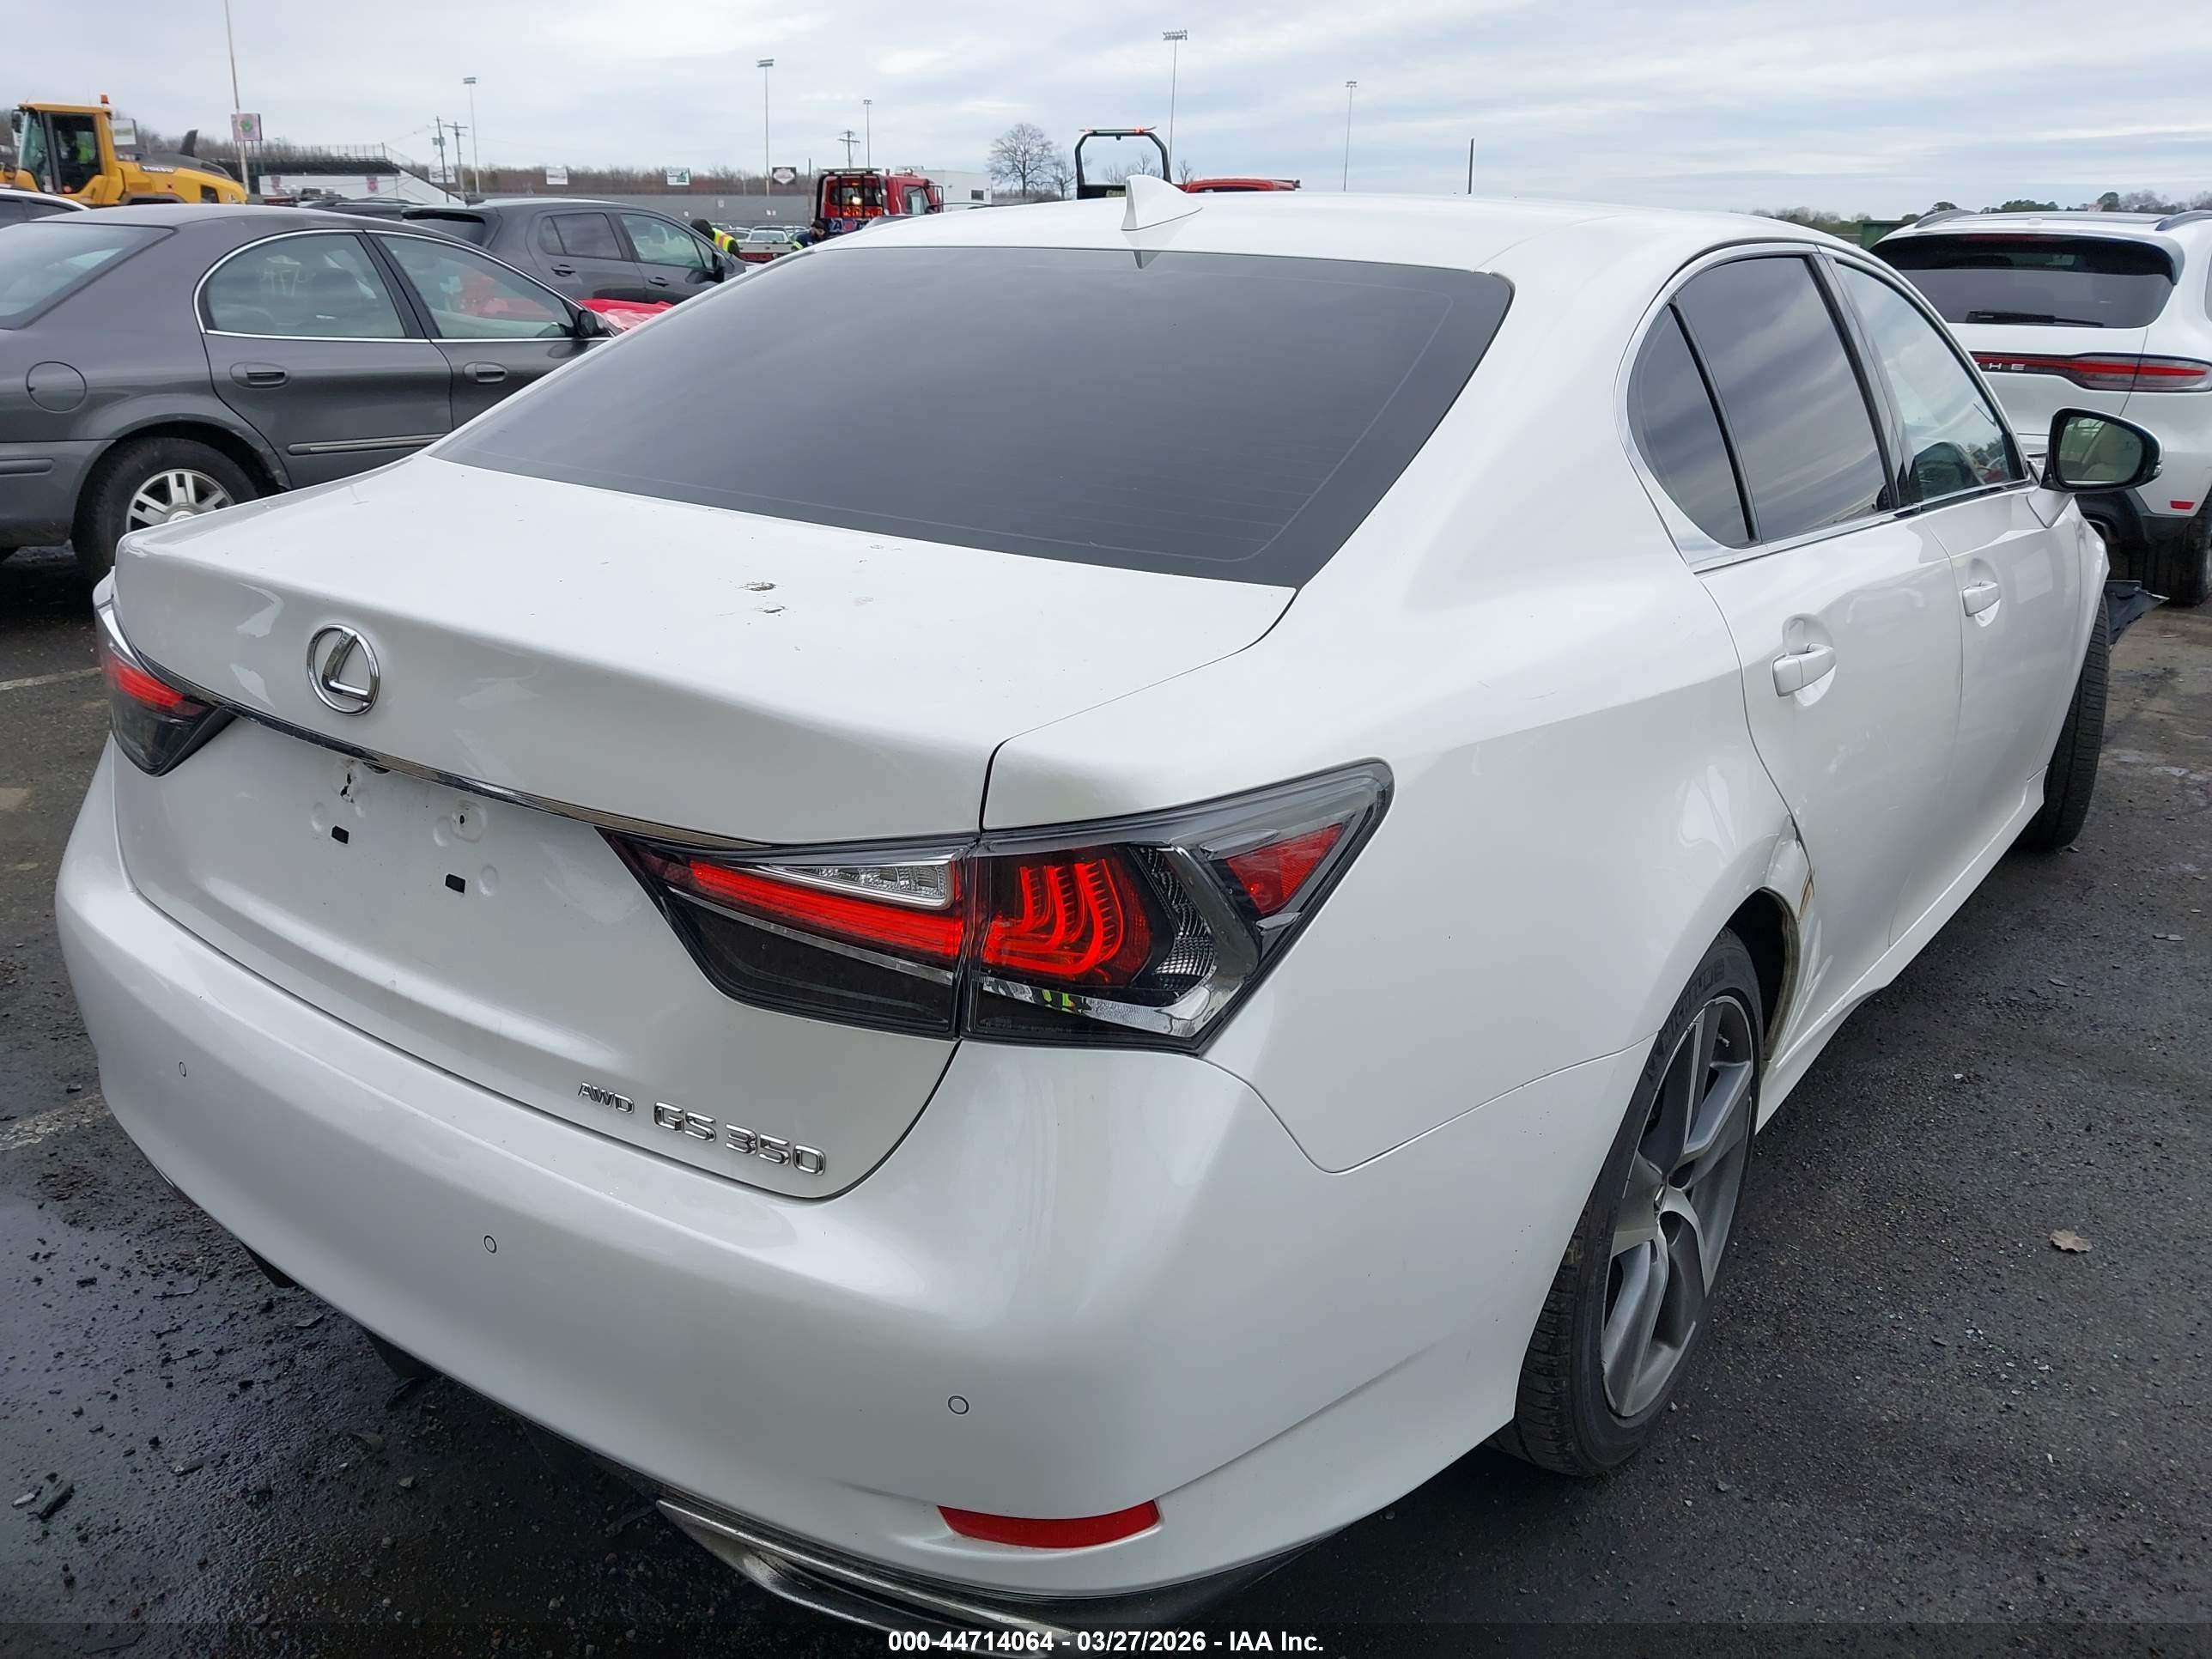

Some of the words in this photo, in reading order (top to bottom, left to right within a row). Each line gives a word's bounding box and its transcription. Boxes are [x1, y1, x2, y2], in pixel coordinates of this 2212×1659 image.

[1975, 362, 2027, 372] HE
[578, 1082, 635, 1114] AWD
[653, 1101, 716, 1142] GS
[726, 1122, 826, 1176] 350
